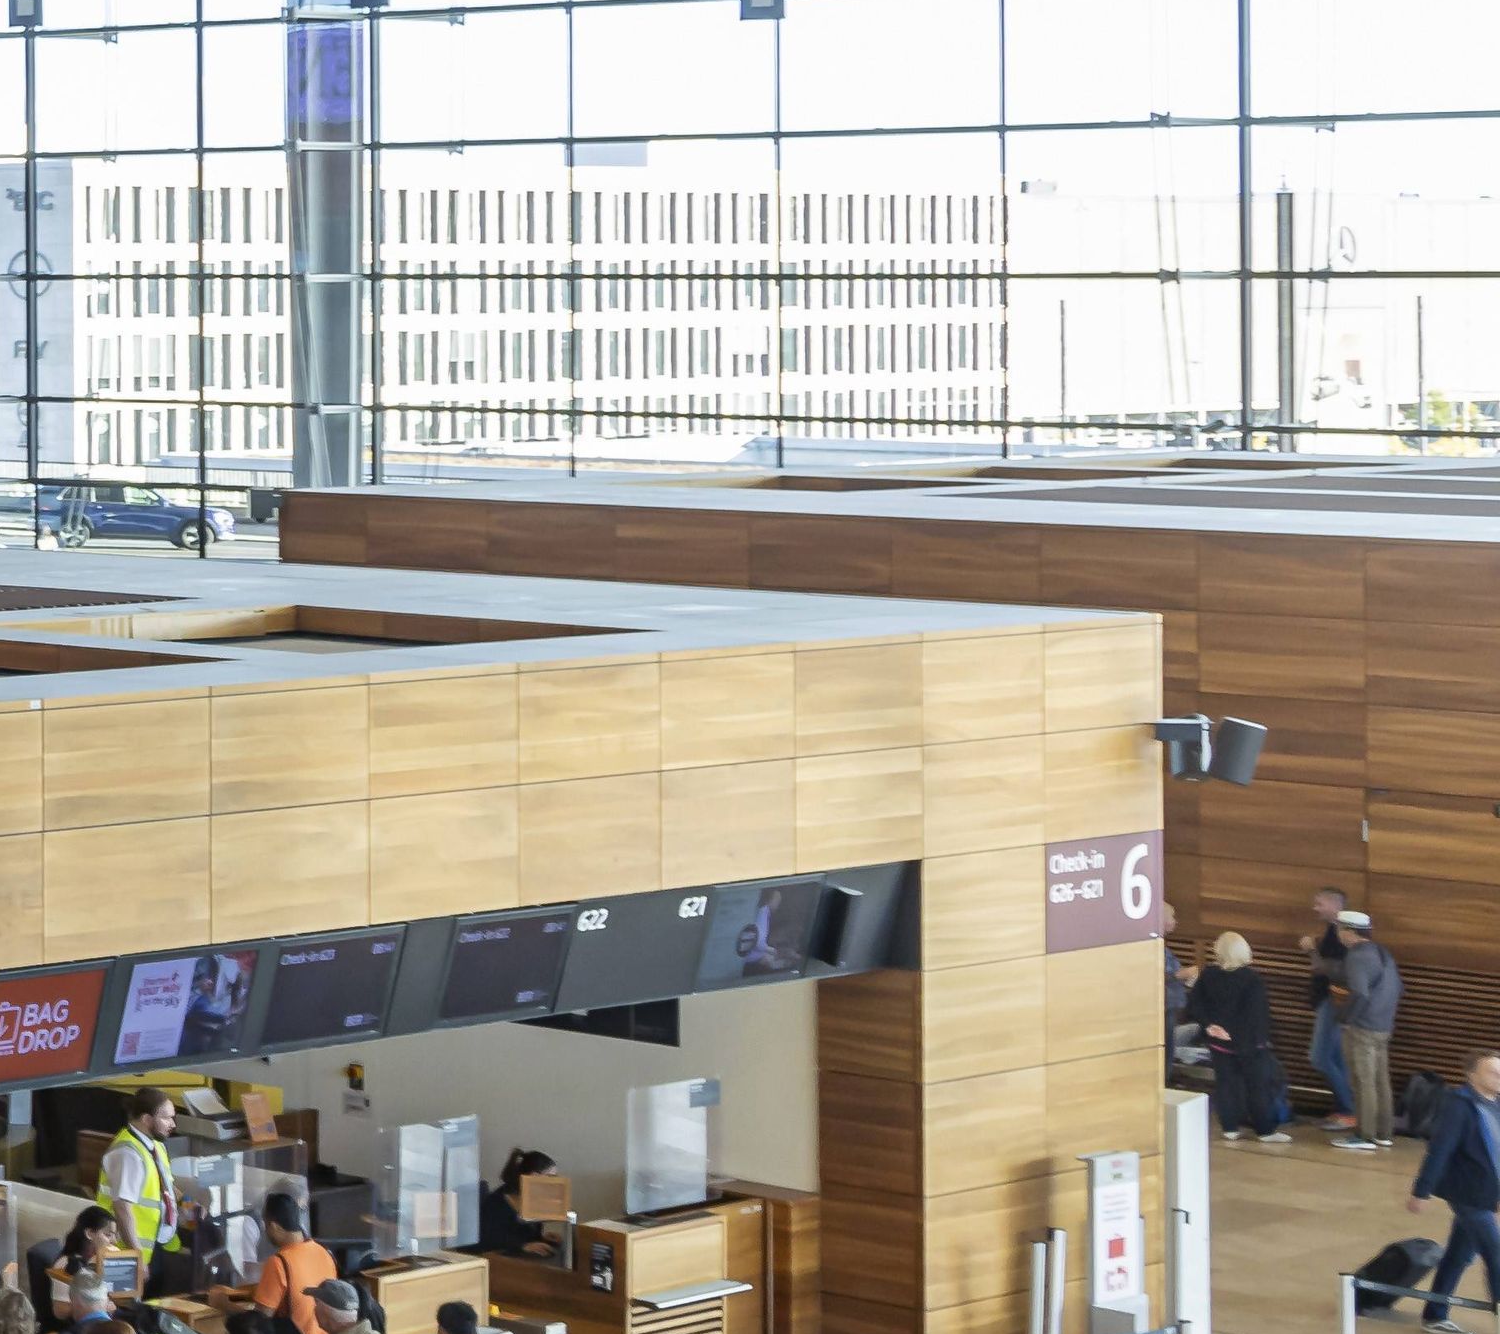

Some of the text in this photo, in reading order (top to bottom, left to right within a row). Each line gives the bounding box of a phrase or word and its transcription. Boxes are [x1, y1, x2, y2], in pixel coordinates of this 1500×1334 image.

[1049, 849, 1106, 874] Check-in
[1120, 843, 1152, 920] 6
[677, 895, 708, 919] 621
[576, 908, 609, 933] 622
[20, 999, 70, 1027] BAG
[17, 1025, 81, 1055] DROP
